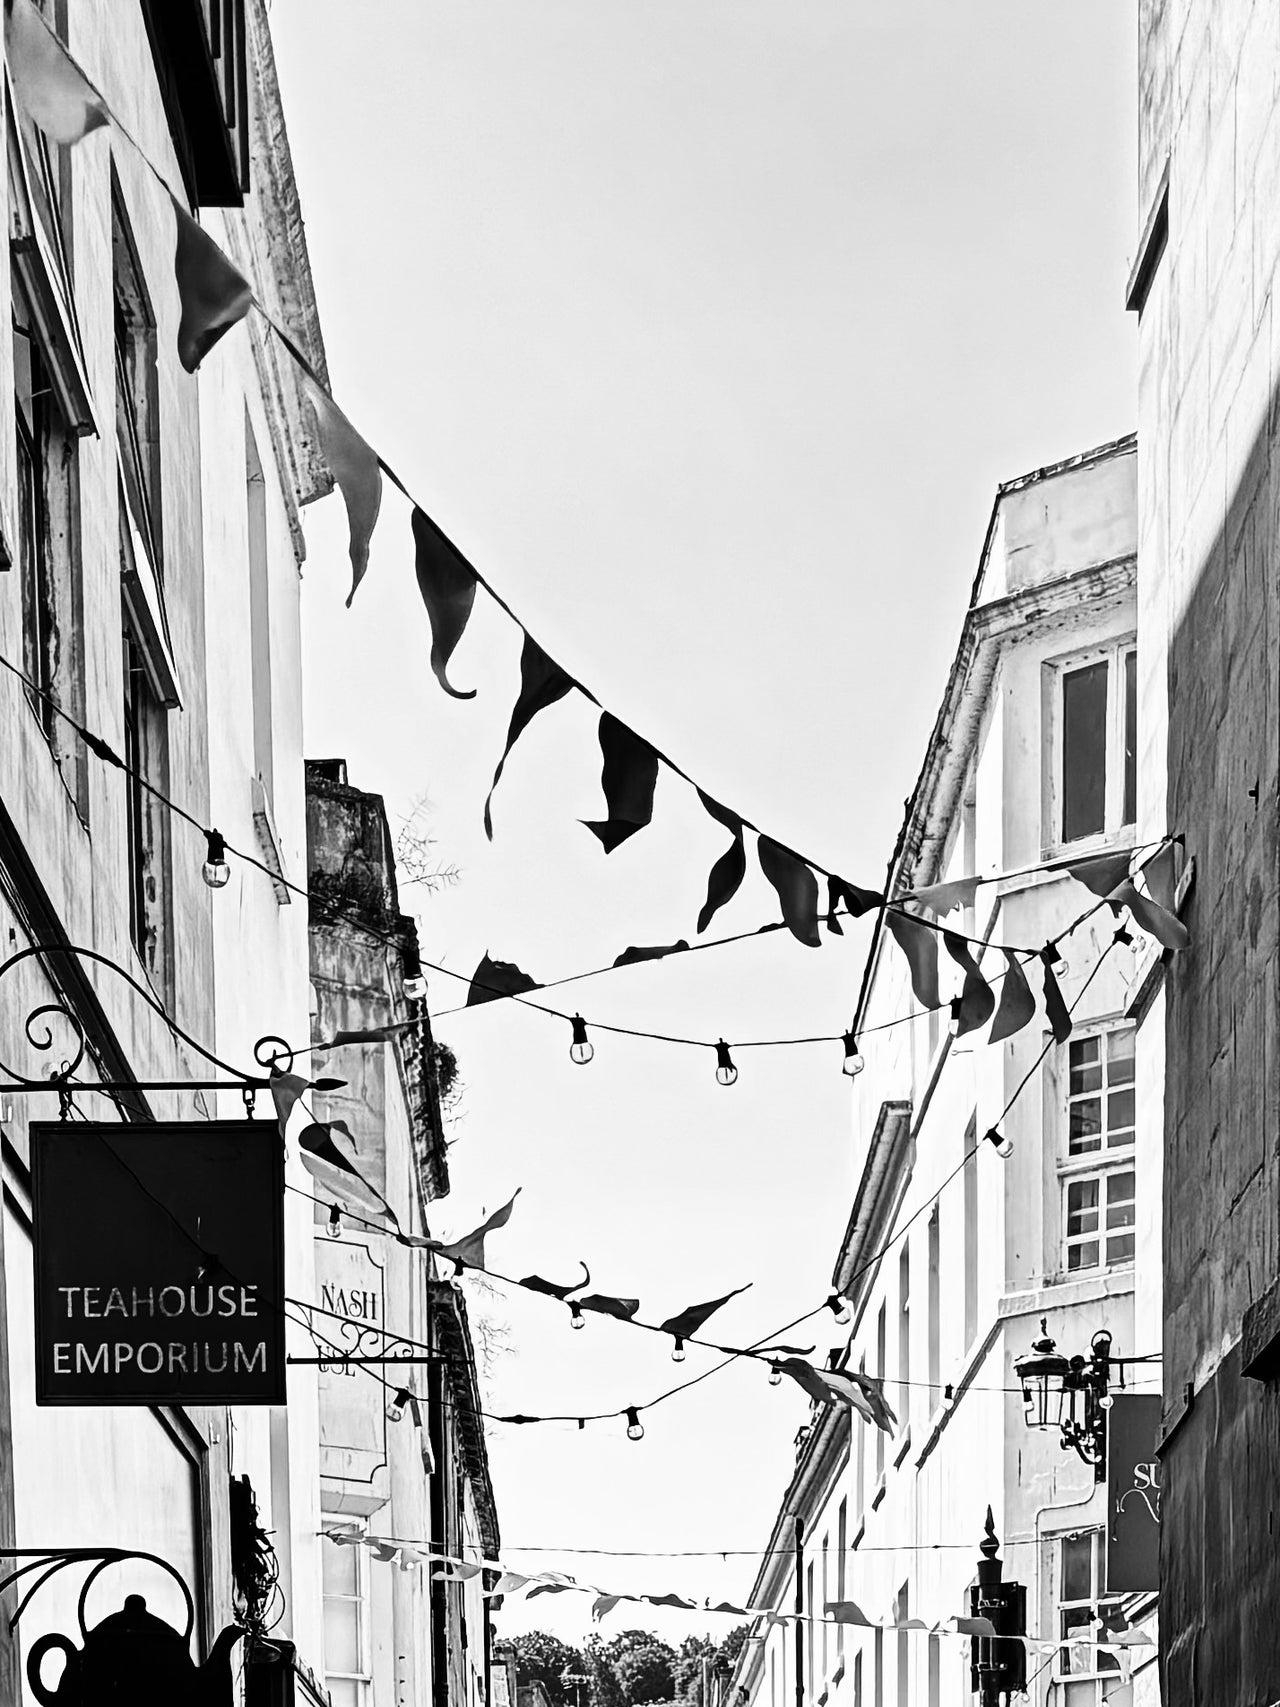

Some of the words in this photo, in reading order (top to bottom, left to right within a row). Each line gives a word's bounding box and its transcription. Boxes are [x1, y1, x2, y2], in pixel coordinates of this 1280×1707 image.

[57, 1284, 258, 1318] TEAHOUSE
[321, 1284, 378, 1320] NASH
[53, 1342, 268, 1374] EMPORIUM
